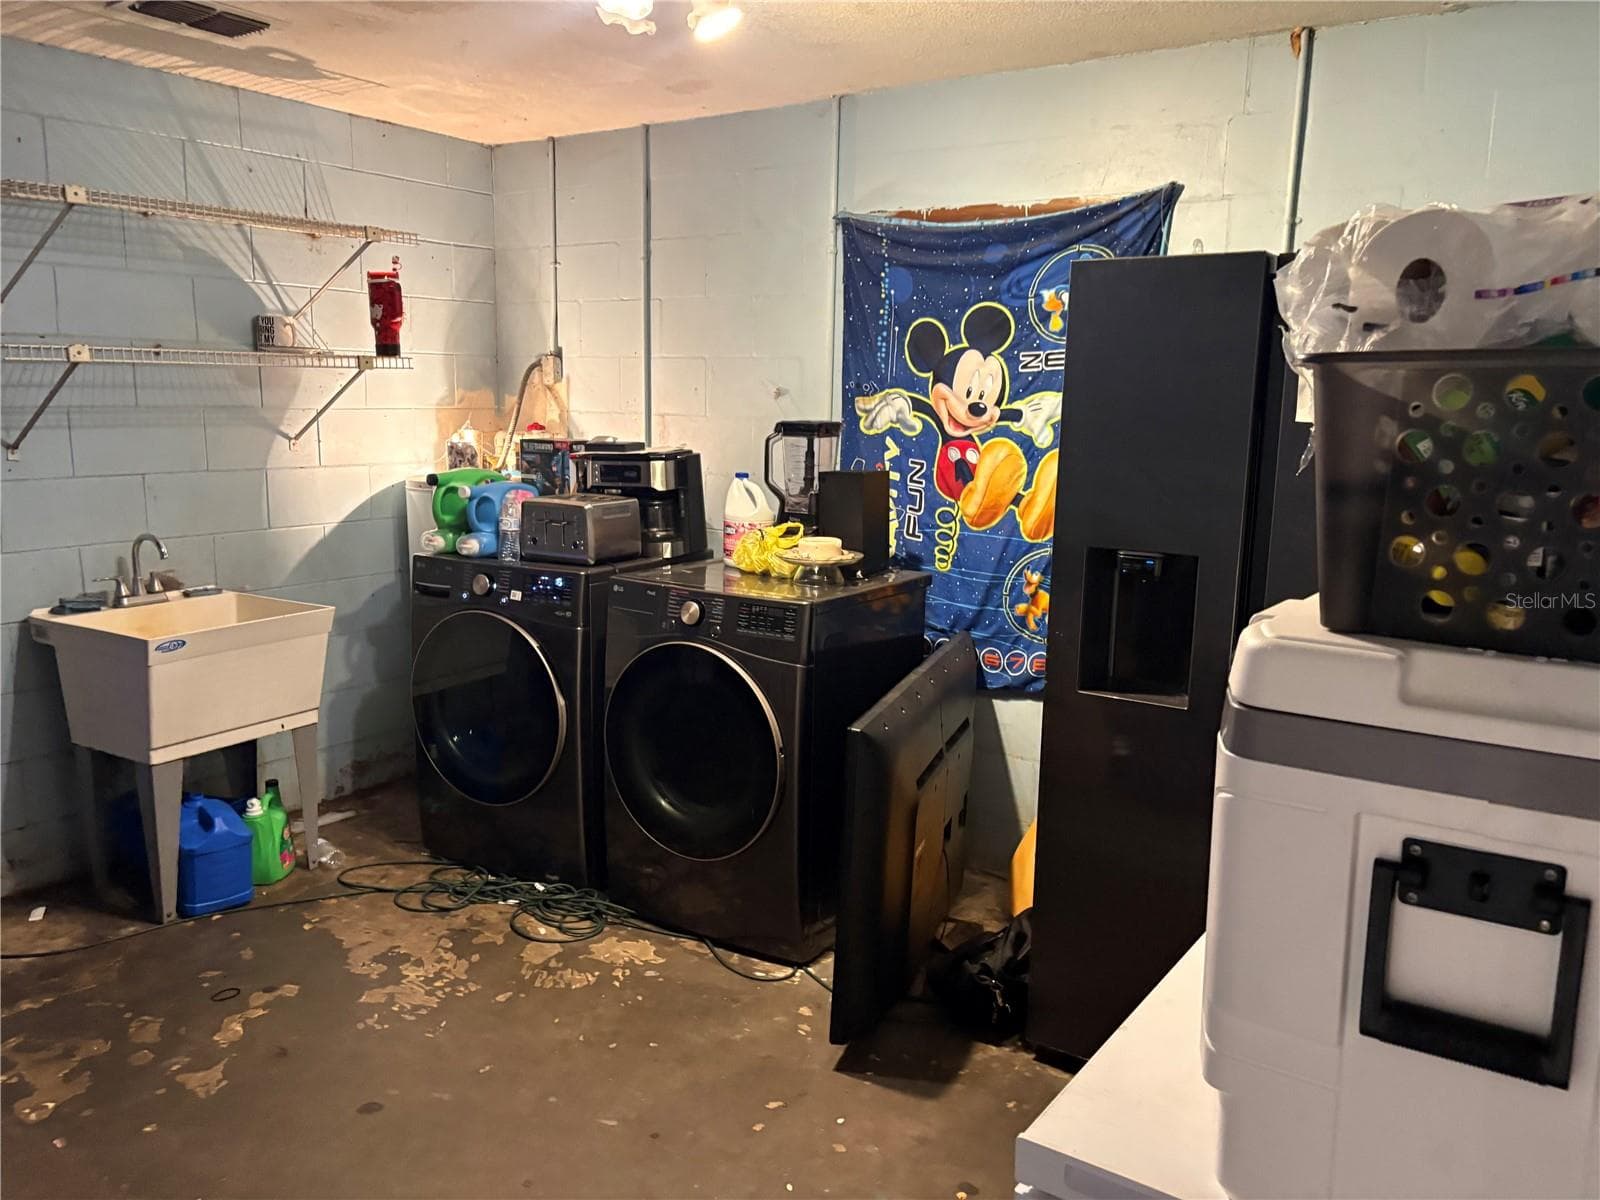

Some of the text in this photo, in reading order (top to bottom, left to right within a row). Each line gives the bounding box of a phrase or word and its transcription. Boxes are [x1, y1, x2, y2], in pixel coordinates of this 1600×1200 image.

[261, 316, 274, 325] YOU
[904, 458, 926, 541] FUN
[1009, 656, 1024, 669] 7
